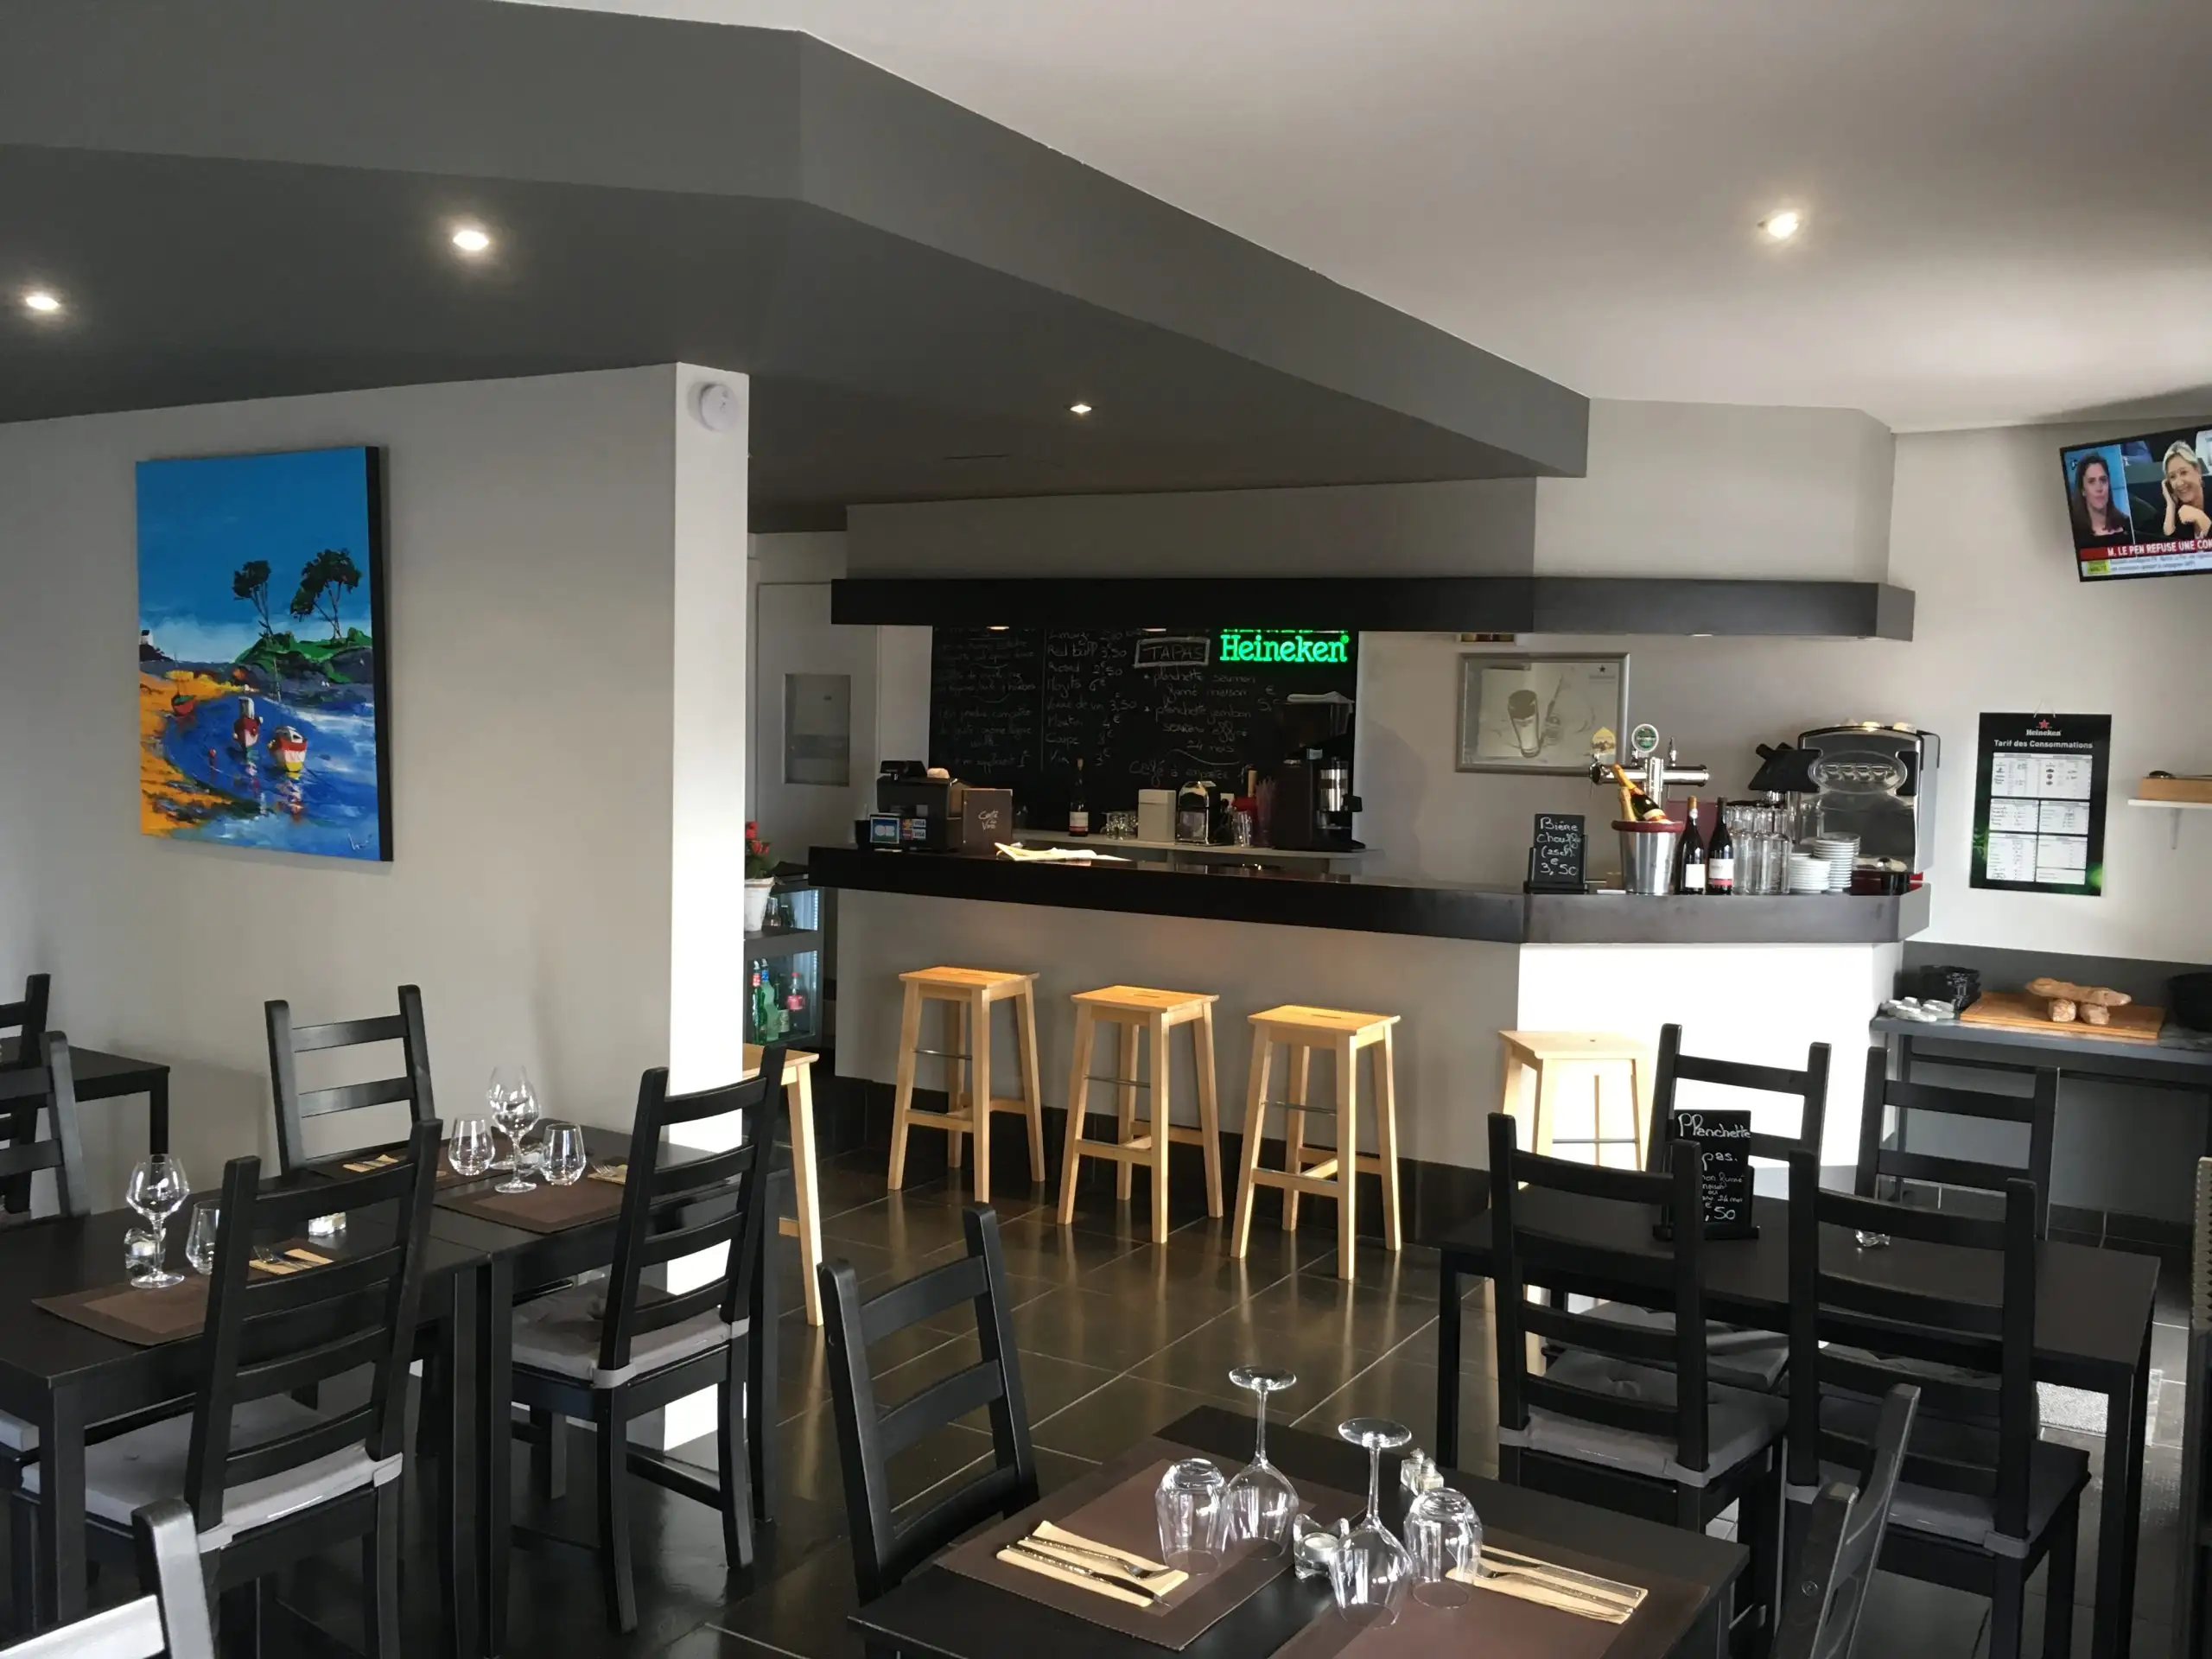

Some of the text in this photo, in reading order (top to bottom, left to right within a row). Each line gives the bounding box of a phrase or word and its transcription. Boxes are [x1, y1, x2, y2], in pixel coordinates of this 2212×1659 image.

[2107, 546, 2116, 557] M.
[2118, 546, 2127, 556] LE
[2129, 544, 2145, 555] PEN
[2145, 543, 2177, 554] REFUSE
[2178, 540, 2195, 551] UNE
[1141, 644, 1205, 661] TAPAS
[1219, 634, 1348, 663] Heineken
[1993, 739, 2012, 747] Tarif
[2029, 740, 2094, 750] Consommations
[1678, 1112, 1751, 1138] Planchette
[1701, 1152, 1738, 1172] pas.
